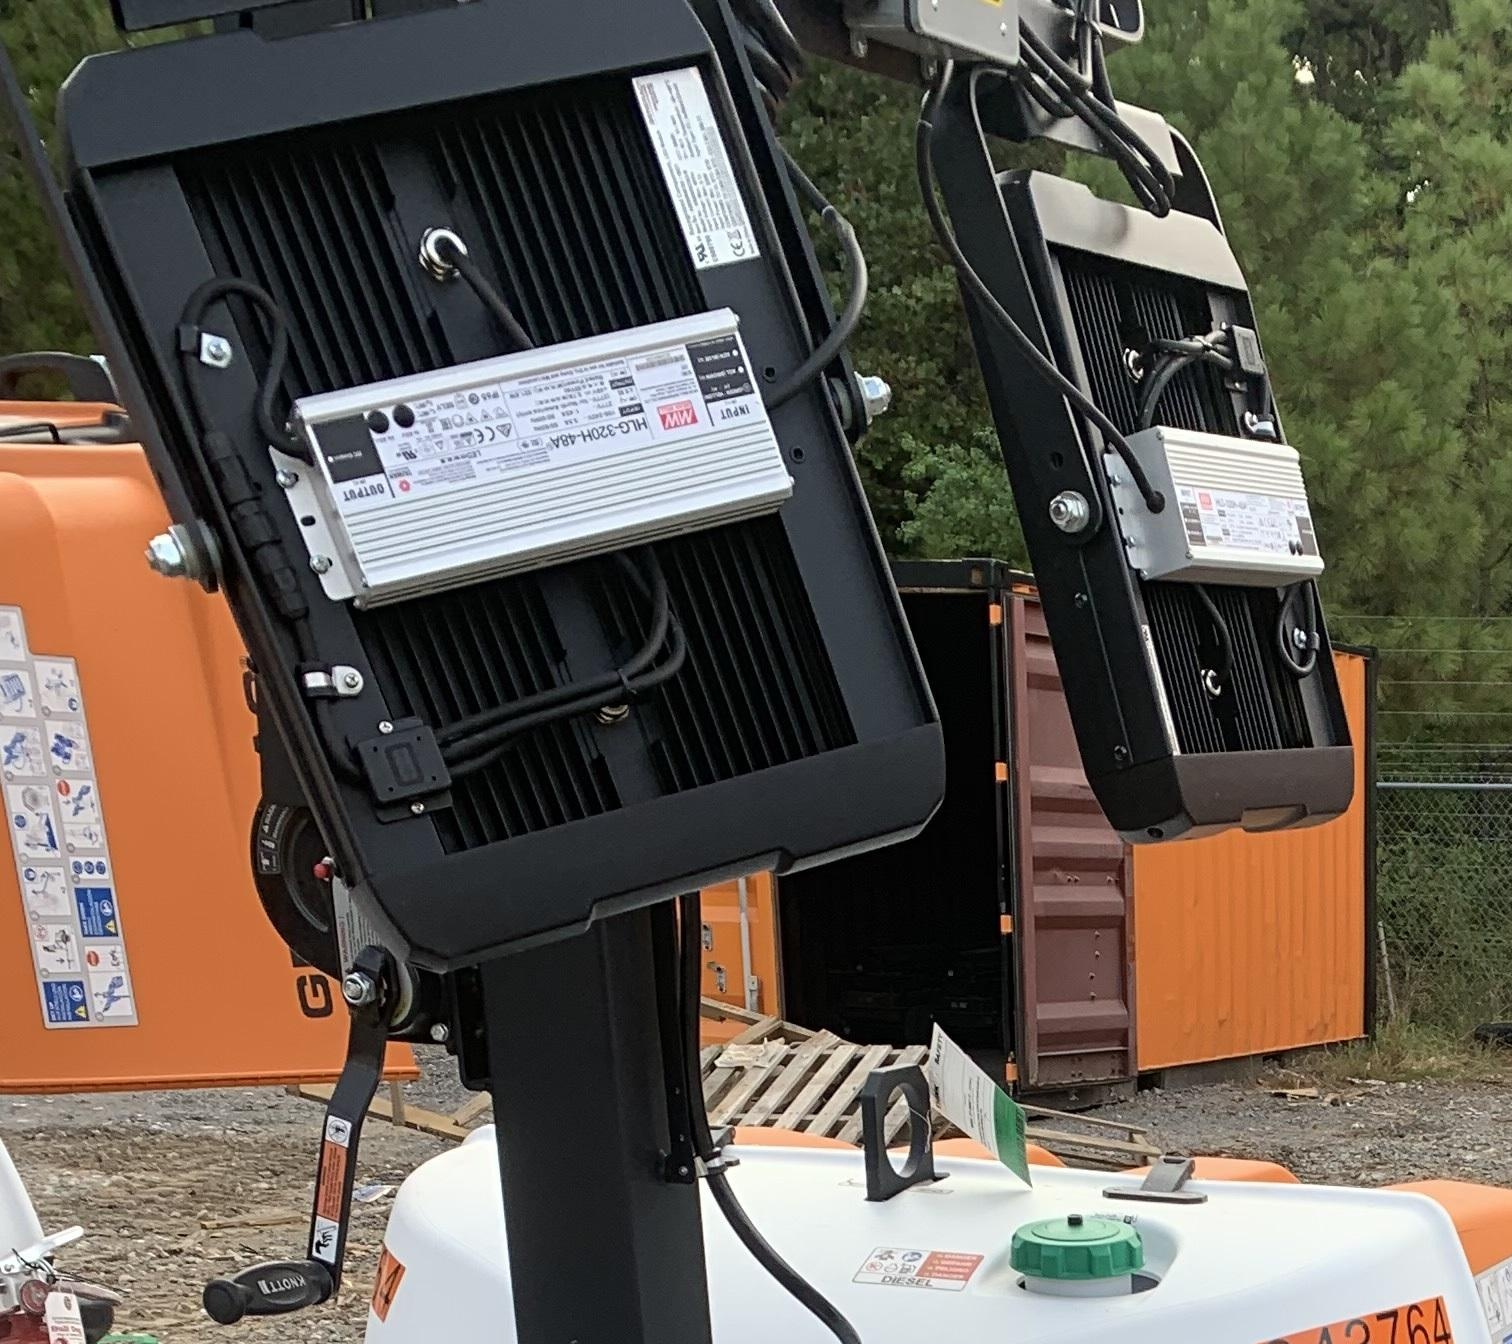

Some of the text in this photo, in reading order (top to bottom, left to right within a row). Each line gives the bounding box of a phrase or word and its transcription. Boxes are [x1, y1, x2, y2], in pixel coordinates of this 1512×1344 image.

[660, 408, 693, 427] MW
[719, 403, 749, 419] INPUT
[549, 416, 647, 448] HLG-320H-48A
[342, 482, 384, 501] OUTPUT
[269, 1274, 305, 1292] KNOTT
[881, 1275, 933, 1287] DIESEL
